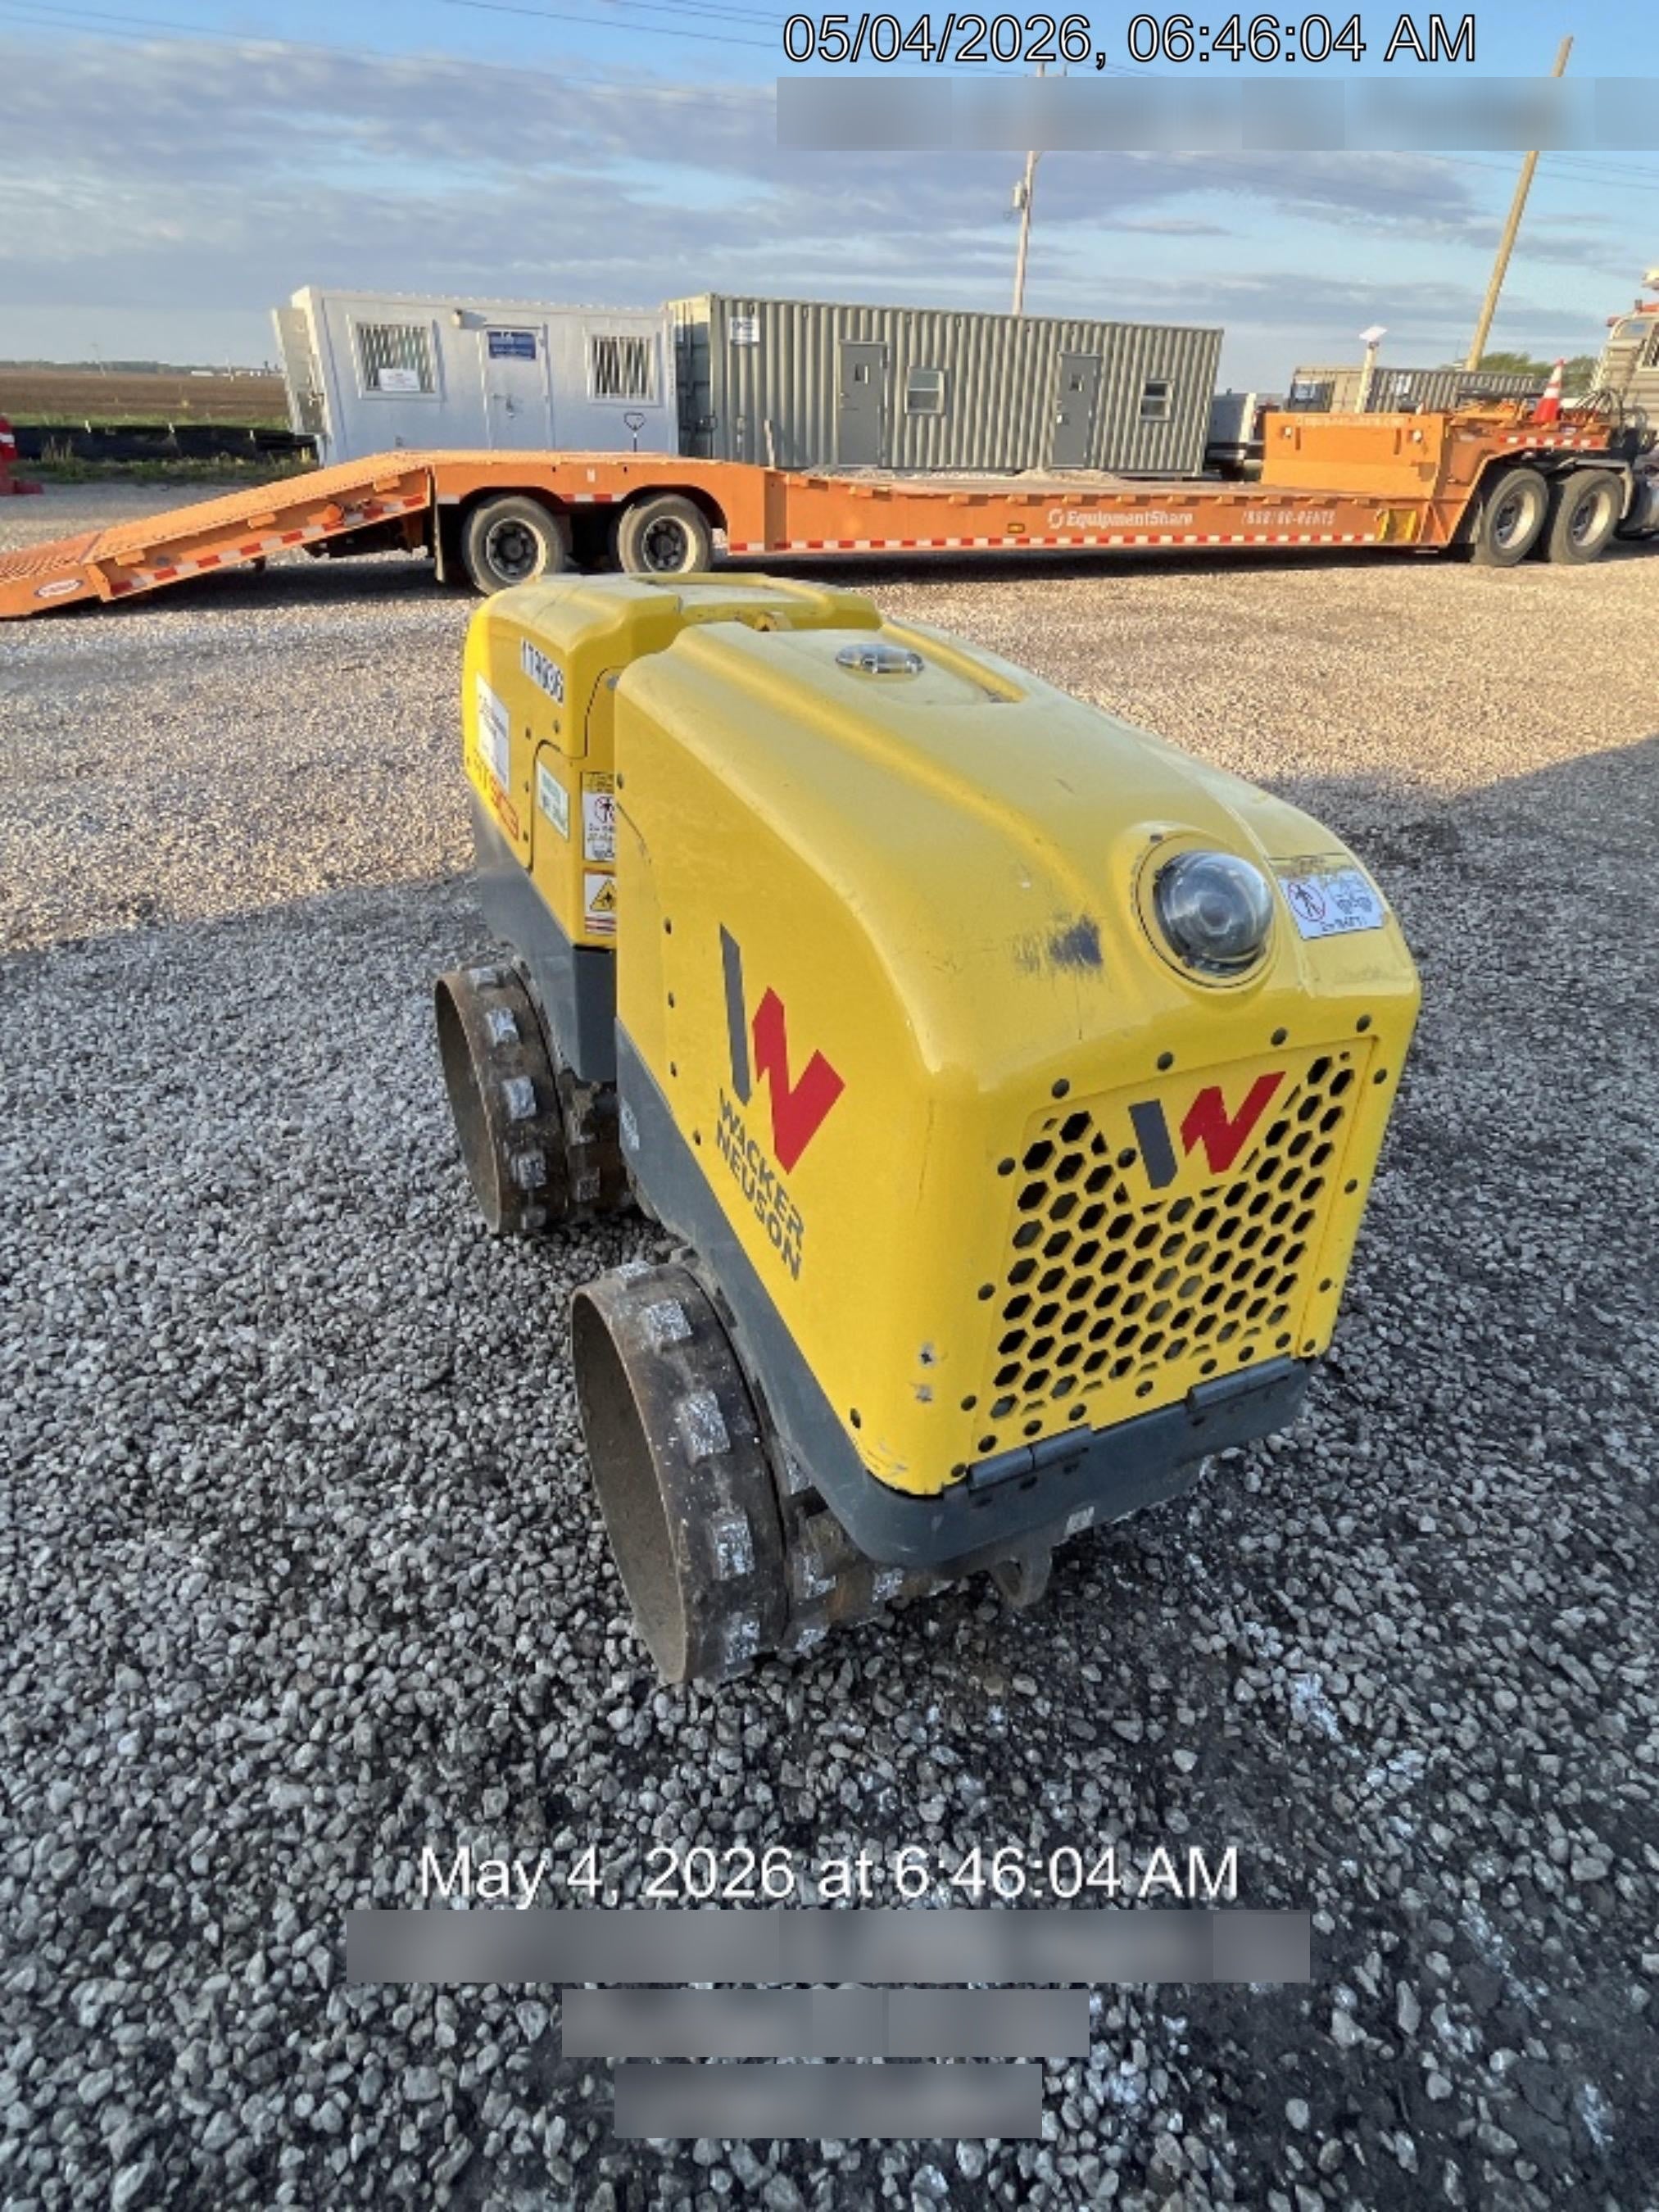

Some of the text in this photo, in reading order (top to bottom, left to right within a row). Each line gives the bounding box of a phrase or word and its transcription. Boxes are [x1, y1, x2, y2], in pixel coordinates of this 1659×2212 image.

[1066, 510, 1193, 529] EquipmentShare
[717, 1119, 802, 1281] NEUSON
[719, 1087, 805, 1251] WACKER
